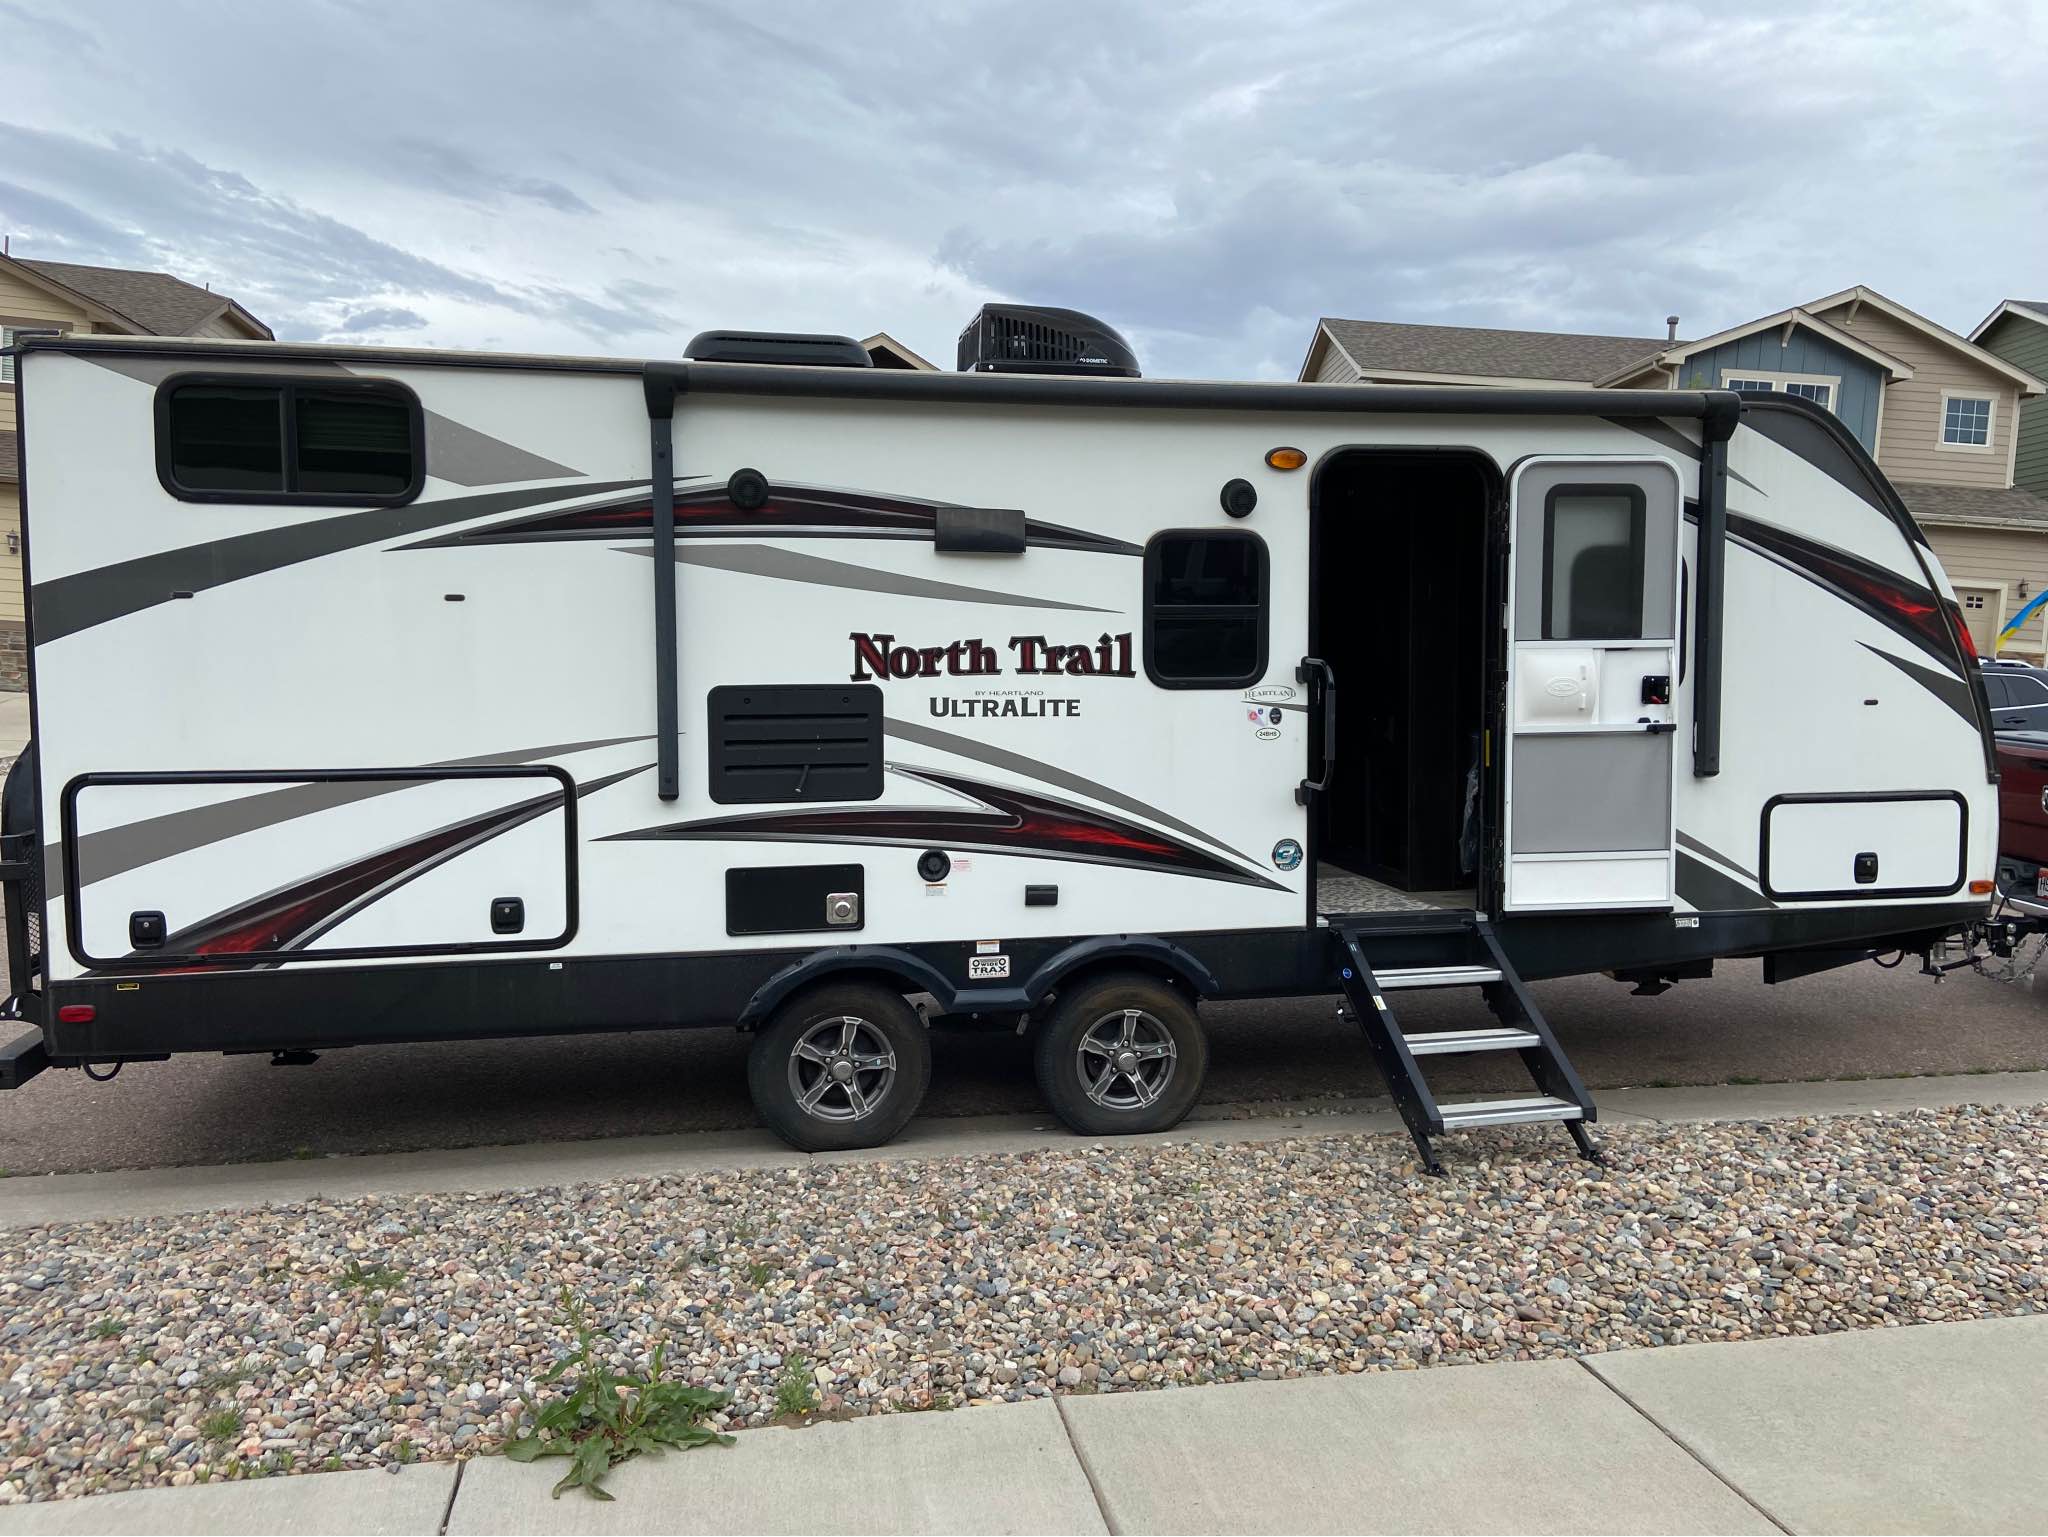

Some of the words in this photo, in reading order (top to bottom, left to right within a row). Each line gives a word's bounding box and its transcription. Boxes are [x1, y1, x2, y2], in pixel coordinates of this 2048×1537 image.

[849, 632, 1003, 682] North
[1008, 631, 1137, 678] Trail
[1244, 689, 1297, 699] HEARTLAND
[971, 966, 1007, 974] TRAX
